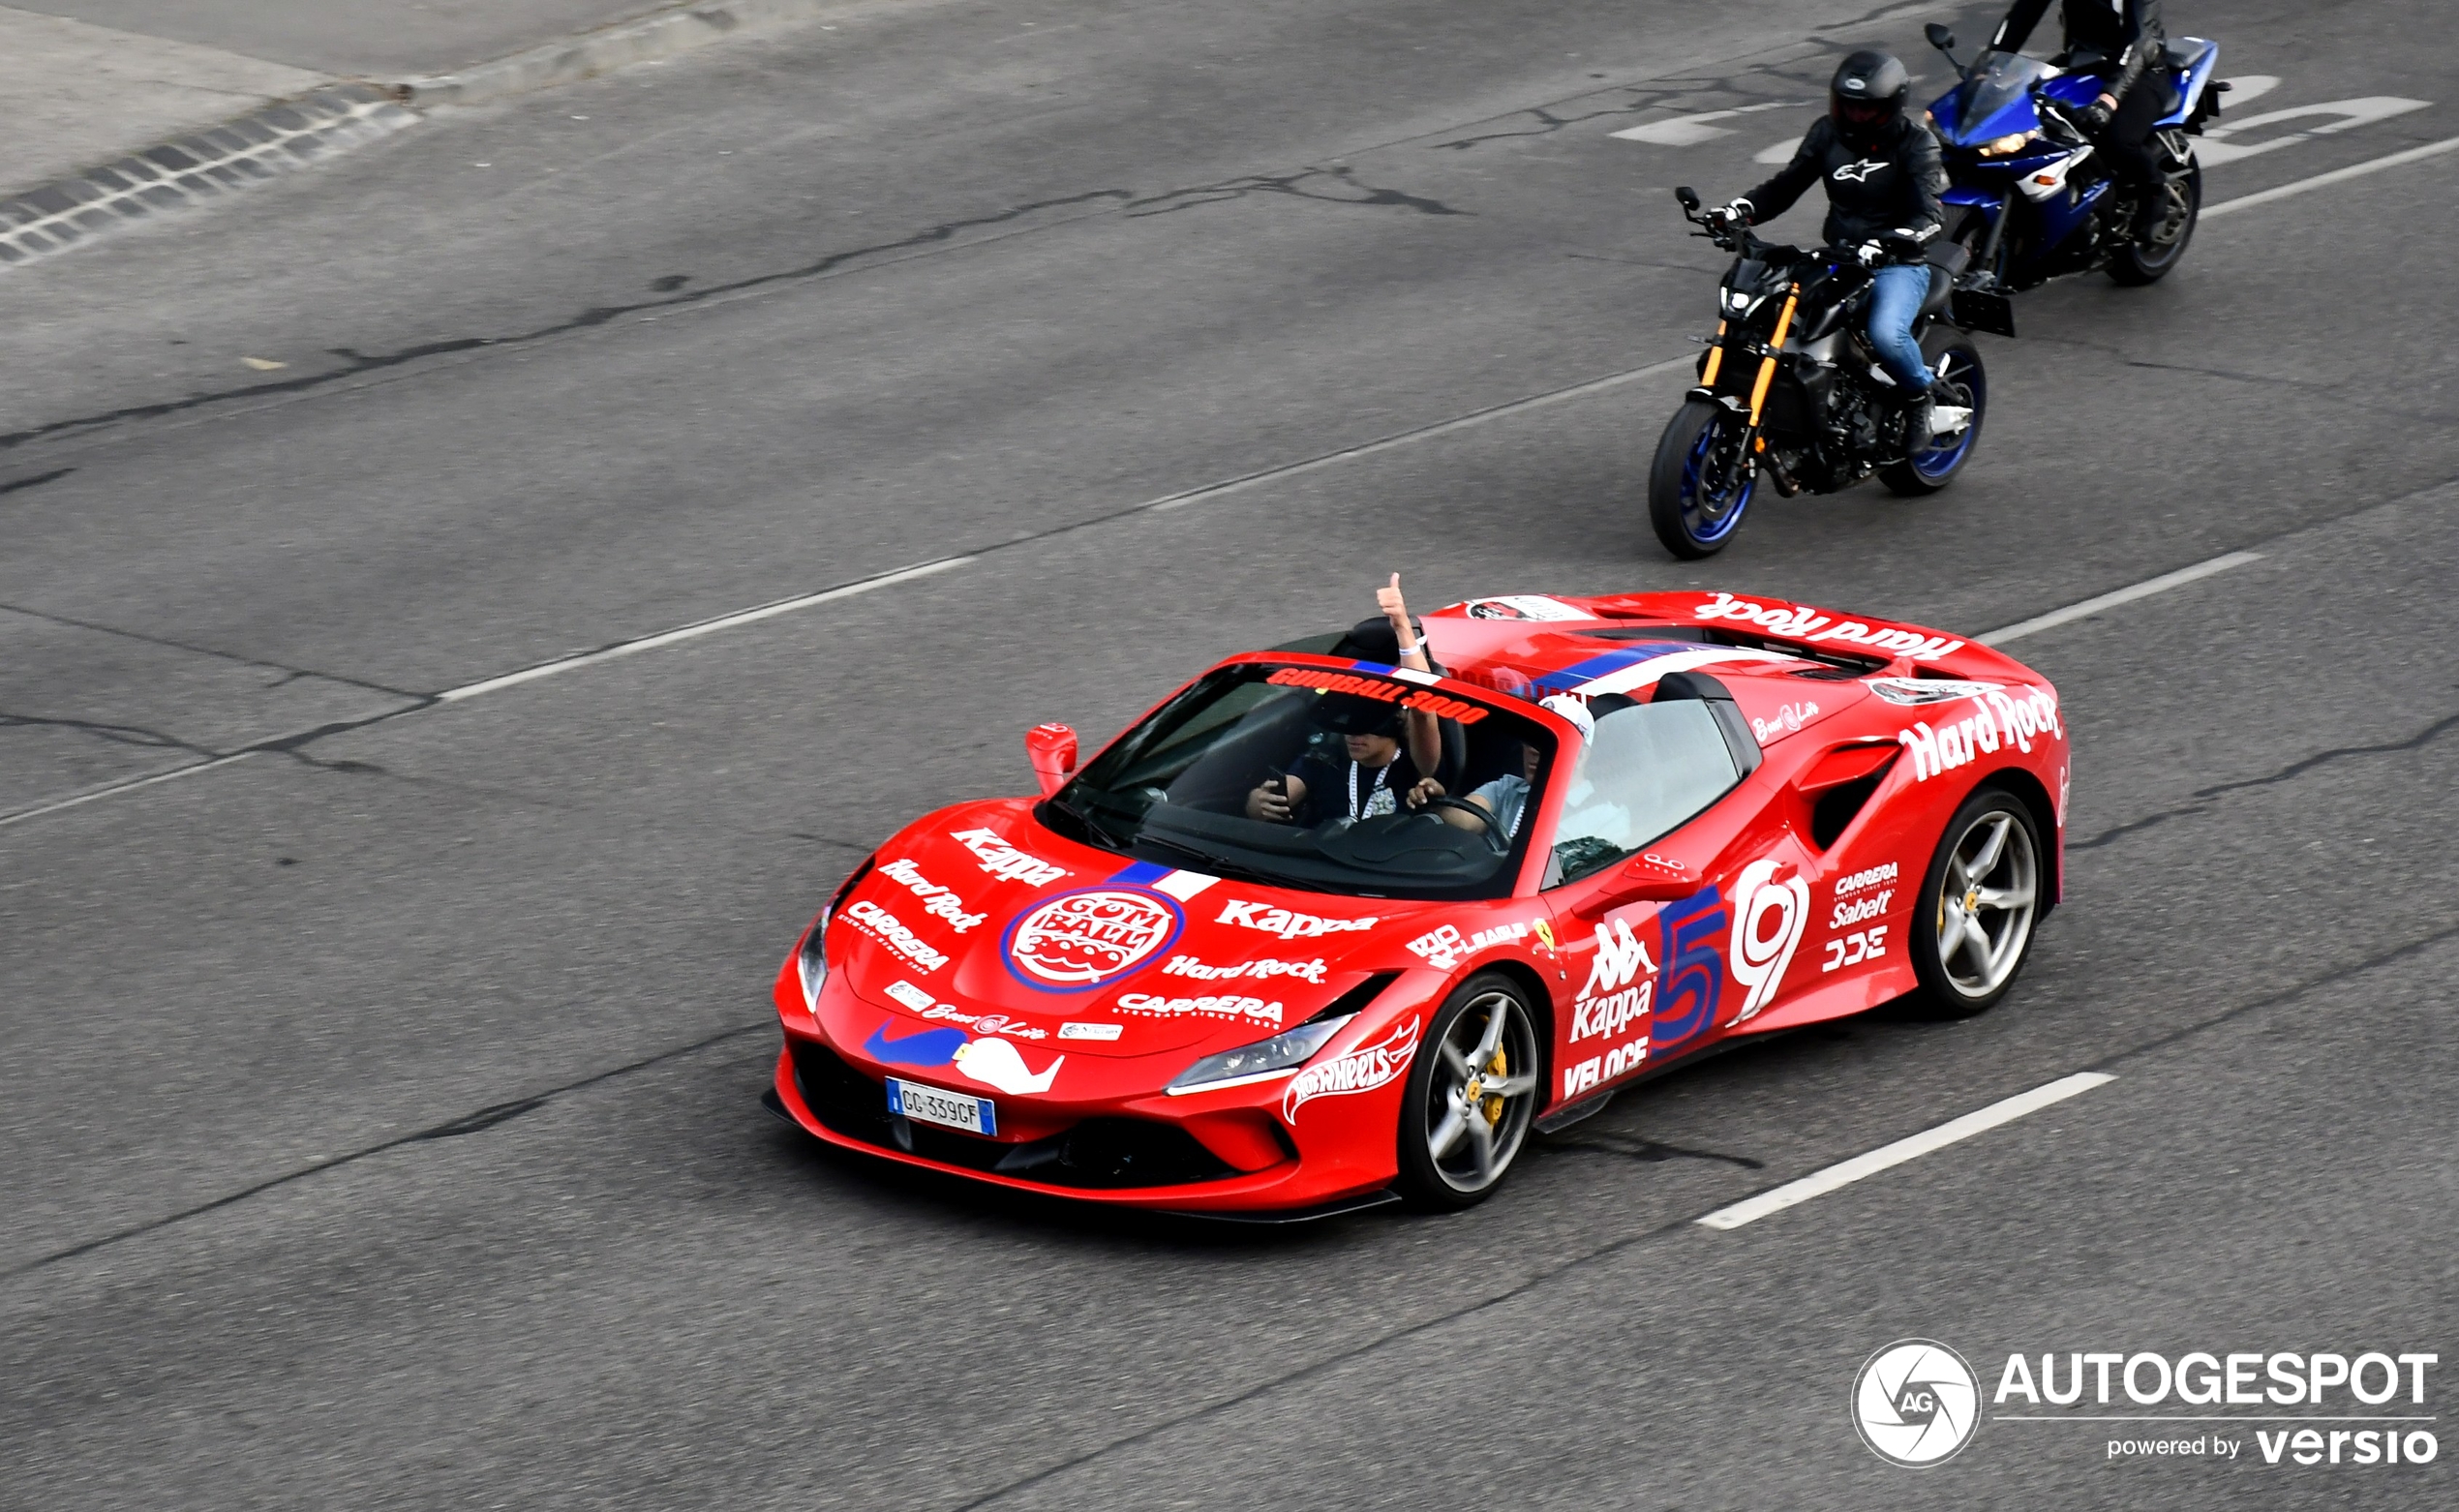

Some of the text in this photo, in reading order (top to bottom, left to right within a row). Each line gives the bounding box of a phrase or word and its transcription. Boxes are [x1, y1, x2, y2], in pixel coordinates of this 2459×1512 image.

[1695, 592, 1965, 661] Hard Rock
[1266, 668, 1407, 703] GUMBALL
[1400, 690, 1490, 724] 3000
[1897, 683, 2062, 782] Hard Rock
[949, 827, 1066, 888] Kappa
[1835, 862, 1897, 895] CARRERA
[878, 859, 988, 934] Hard Rock
[1214, 899, 1379, 939] Kappa
[1829, 890, 1893, 929] Sabelt
[848, 900, 950, 971] CARRERA
[1162, 955, 1327, 983] Hard Rock
[1117, 993, 1283, 1023] CARRERA
[1569, 981, 1652, 1044] Kappa
[1293, 1073, 1320, 1102] HOT
[1563, 1036, 1650, 1101] VELOCE
[902, 1090, 923, 1112] GG
[926, 1095, 976, 1124] 339GF
